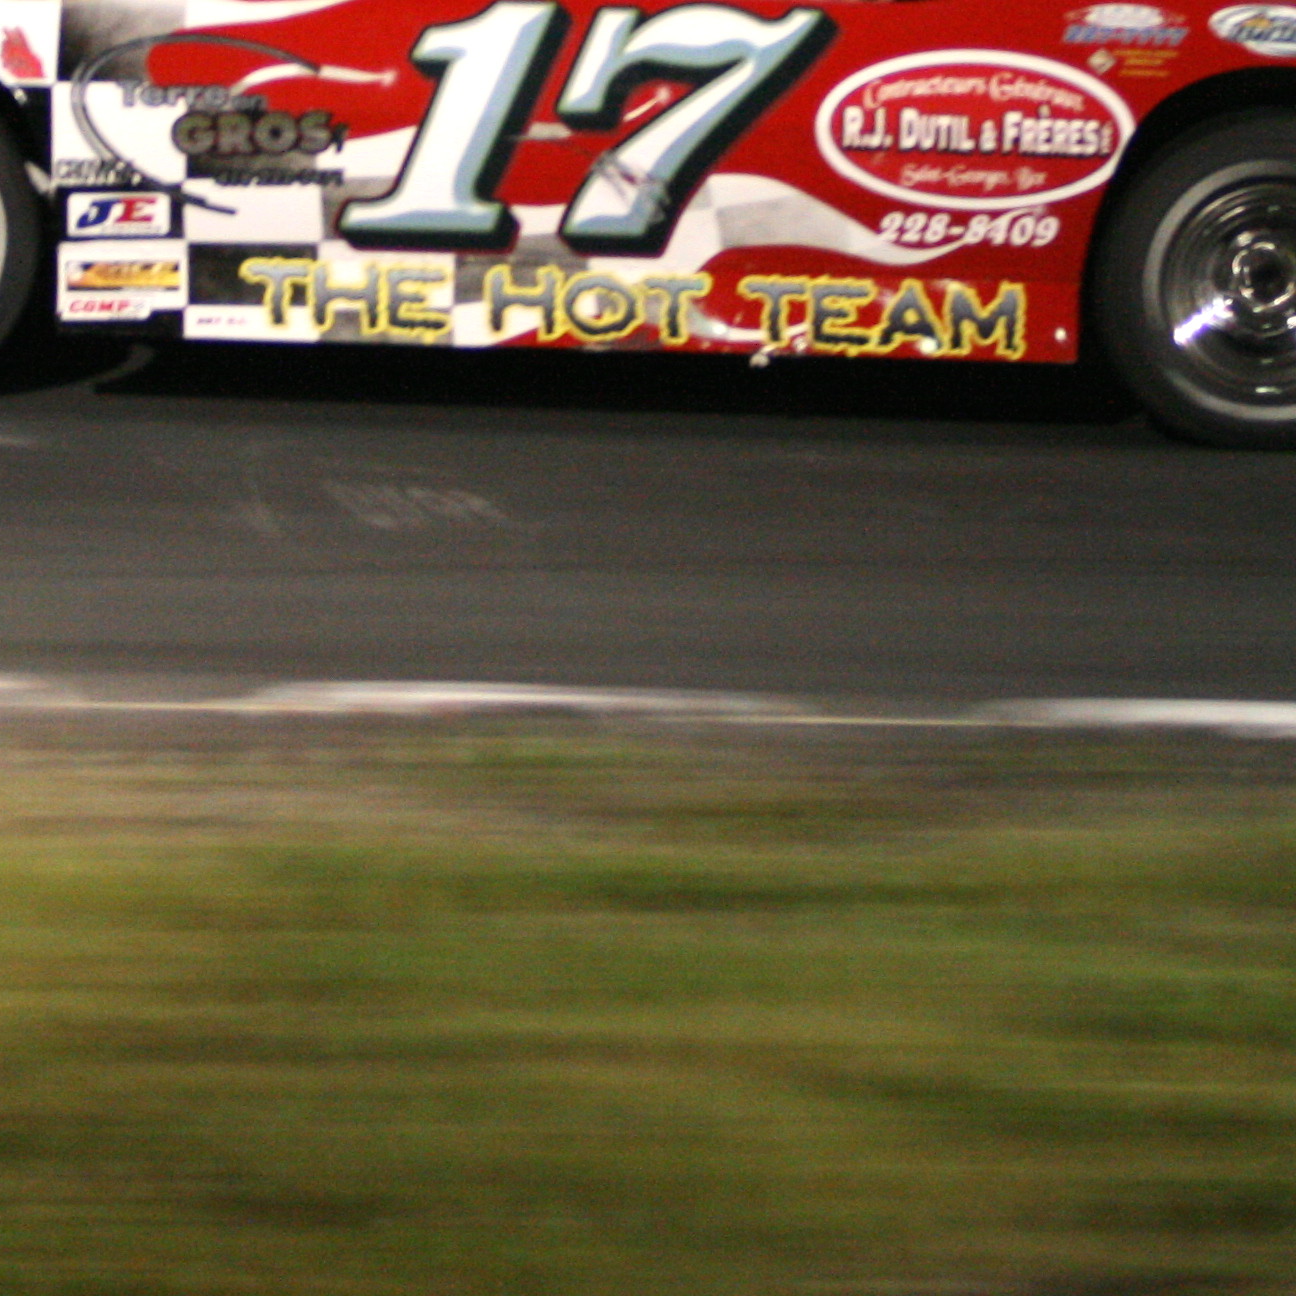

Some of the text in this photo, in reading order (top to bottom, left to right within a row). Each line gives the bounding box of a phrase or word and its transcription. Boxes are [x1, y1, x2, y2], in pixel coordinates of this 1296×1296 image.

[335, 0, 840, 258] 17
[842, 105, 892, 151] R.J.
[899, 106, 975, 153] DUTIL
[76, 196, 157, 229] JE
[877, 210, 1061, 248] 228-8409
[238, 256, 1027, 360] THE HOT TEAM
